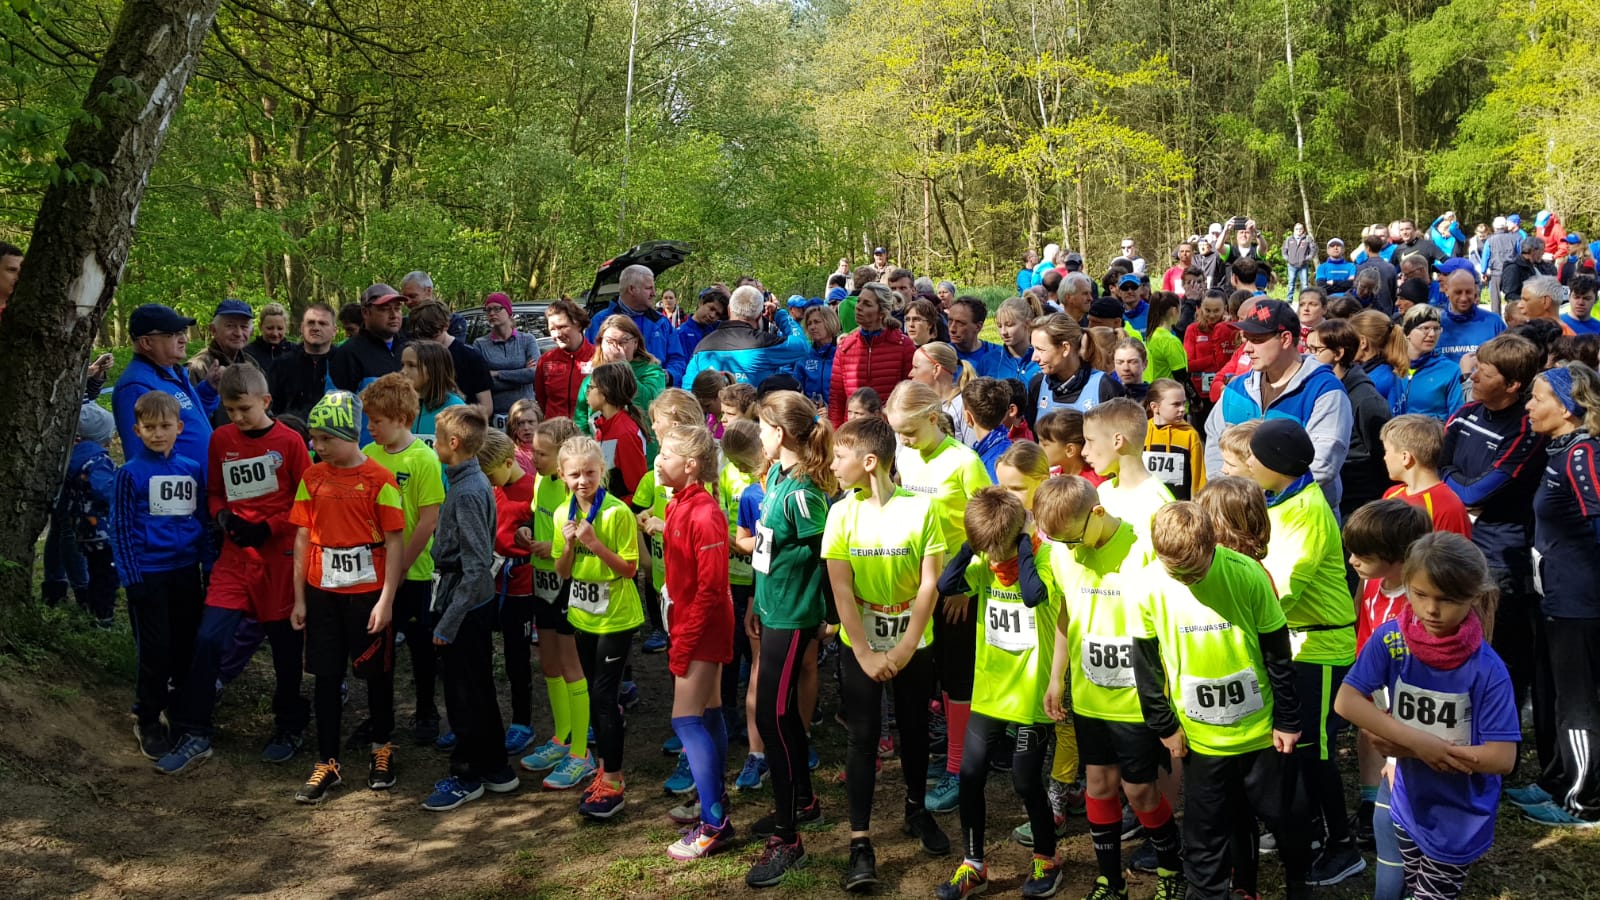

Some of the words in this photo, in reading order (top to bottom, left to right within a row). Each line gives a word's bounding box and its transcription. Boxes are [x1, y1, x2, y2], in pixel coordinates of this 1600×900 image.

[229, 461, 266, 486] 650
[1148, 455, 1174, 473] 674
[160, 480, 193, 501] 649
[331, 553, 362, 573] 461
[857, 548, 911, 557] EURAWASSER
[572, 581, 600, 603] 558
[992, 588, 1023, 601] URAWAS
[989, 605, 1021, 633] 541
[1184, 621, 1233, 633] EURAWASSER
[1088, 640, 1132, 670] 583
[1196, 679, 1246, 709] 679
[1397, 691, 1458, 729] 684
